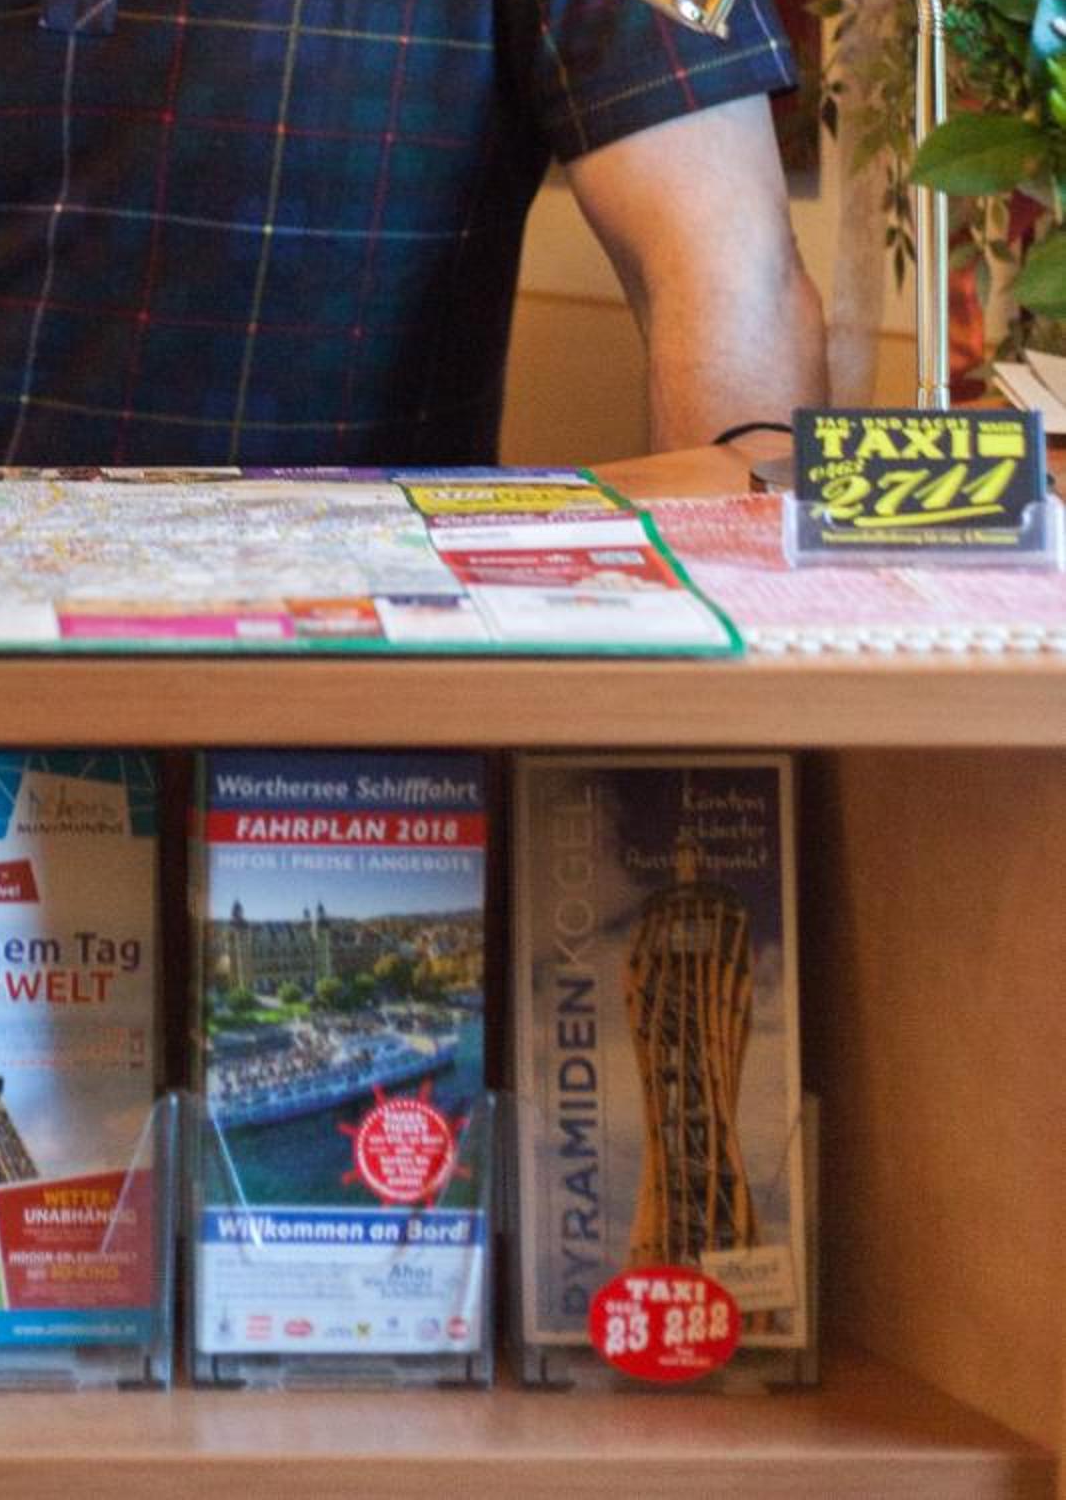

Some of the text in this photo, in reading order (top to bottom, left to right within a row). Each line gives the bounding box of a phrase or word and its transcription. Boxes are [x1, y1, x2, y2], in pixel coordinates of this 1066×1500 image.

[814, 427, 971, 459] TAXI
[810, 459, 1016, 519] 2711
[216, 774, 349, 798] Wörthersee
[236, 816, 459, 842] FAHRPLAN 2018
[74, 931, 141, 971] Tag
[5, 971, 115, 1004] WELT
[552, 784, 600, 1317] PYRAMIDENKOGEL
[217, 1215, 364, 1239] Willkommen
[369, 1222, 399, 1239] an
[626, 1278, 707, 1303] TAXI
